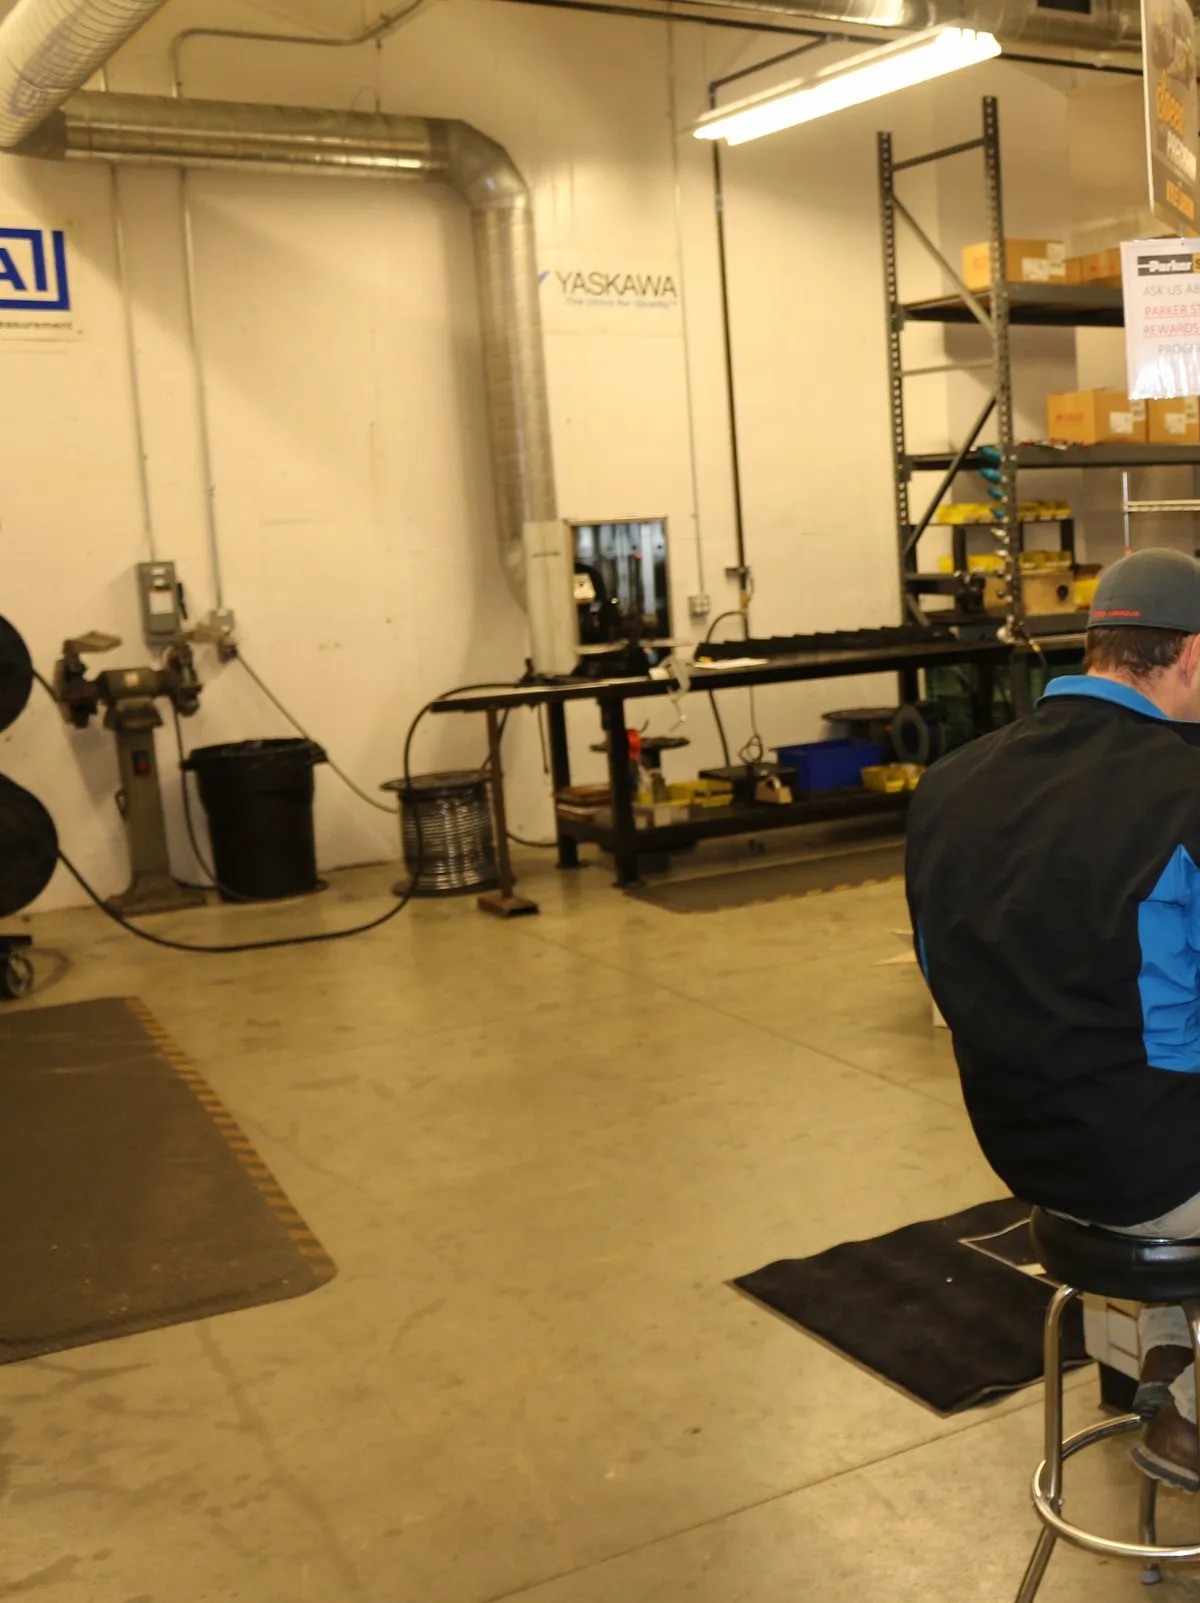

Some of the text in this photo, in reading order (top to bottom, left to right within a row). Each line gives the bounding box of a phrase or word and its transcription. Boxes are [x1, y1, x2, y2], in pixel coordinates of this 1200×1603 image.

[1147, 259, 1192, 273] Parker
[555, 270, 678, 298] YASKAWA
[1143, 285, 1165, 296] ASK
[1167, 284, 1183, 296] US
[1144, 305, 1187, 317] PARKER
[1143, 323, 1200, 336] REWARDS
